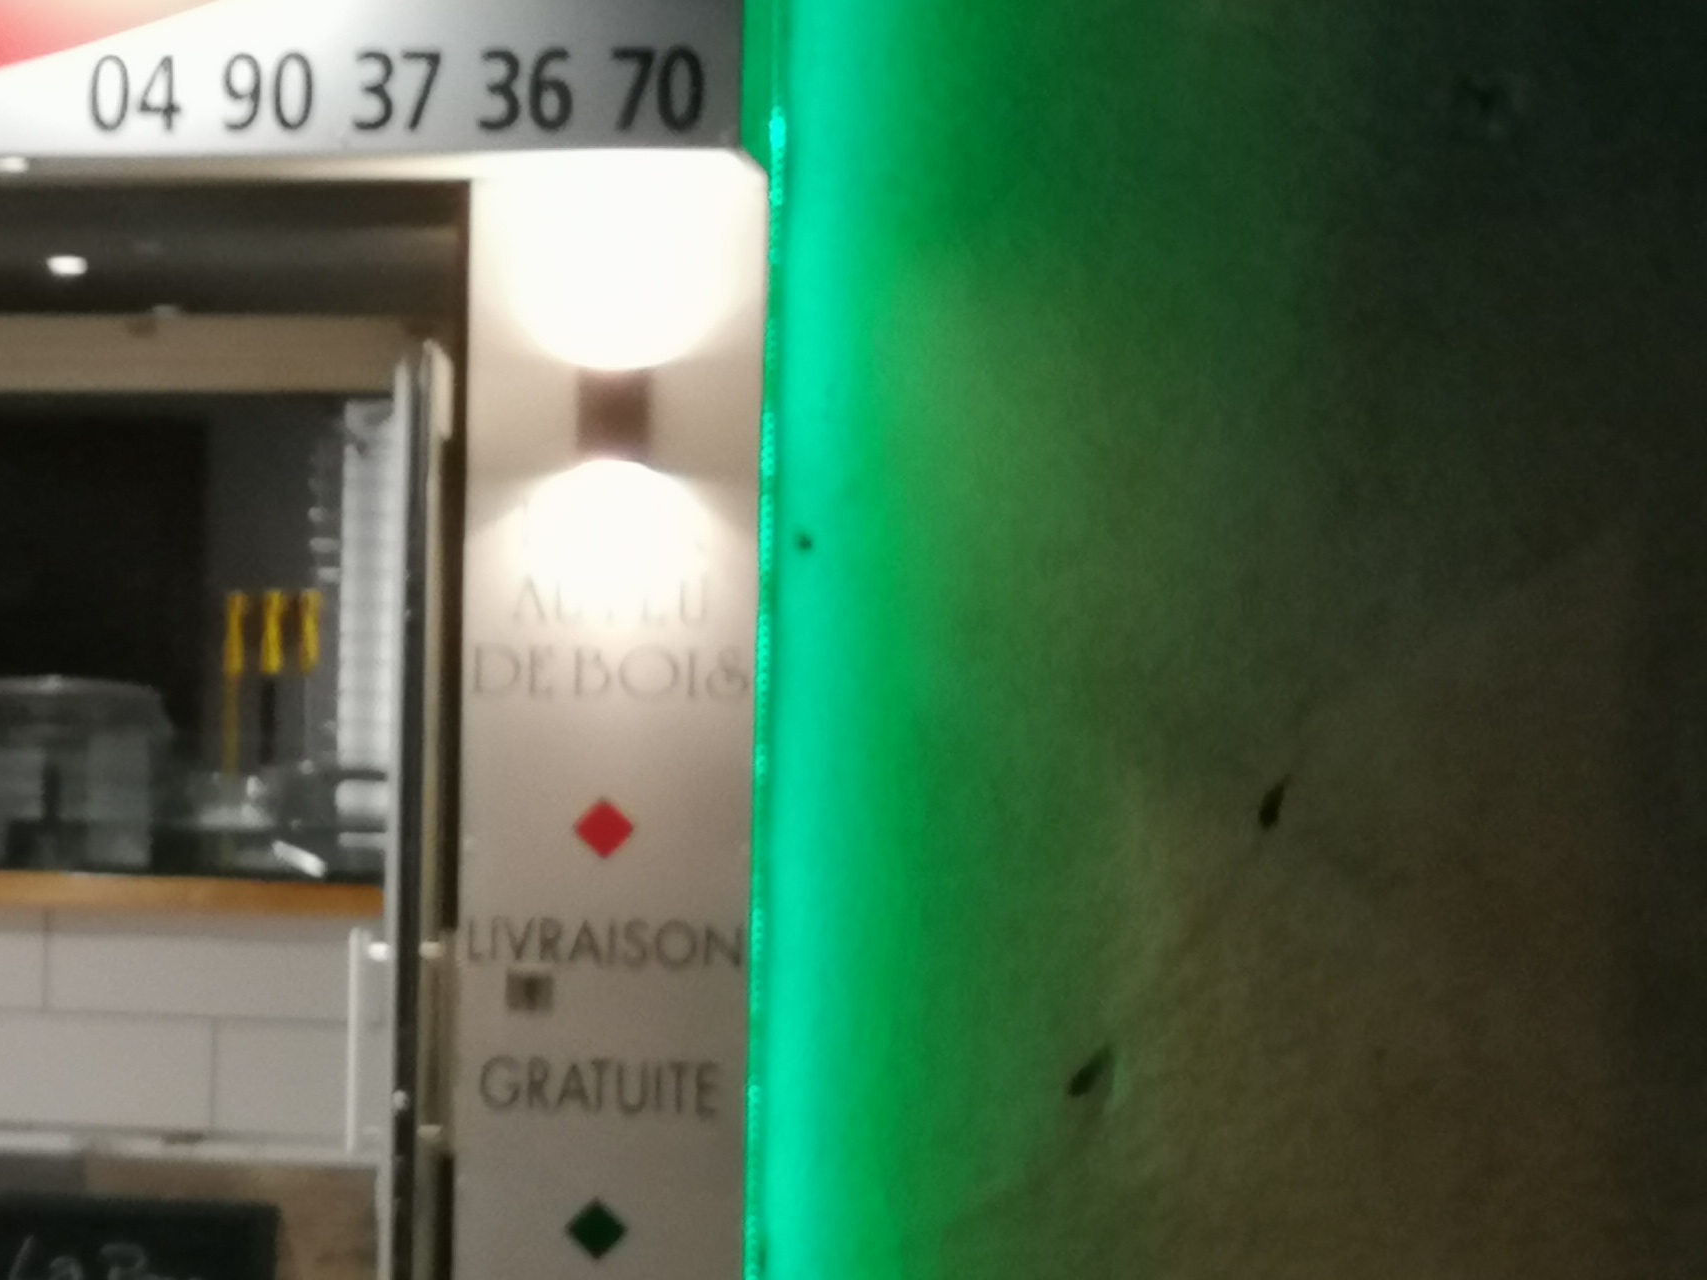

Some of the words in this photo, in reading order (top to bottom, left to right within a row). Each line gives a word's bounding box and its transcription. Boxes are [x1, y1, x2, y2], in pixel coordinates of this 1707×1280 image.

[90, 53, 182, 132] 04
[223, 51, 314, 131] 90
[352, 49, 442, 132] 37
[477, 47, 573, 133] 36
[609, 46, 706, 133] 70
[472, 645, 553, 697] DE
[574, 646, 748, 700] BOIS
[467, 915, 743, 968] LIVRAISON
[479, 1055, 721, 1117] GRATUITE
